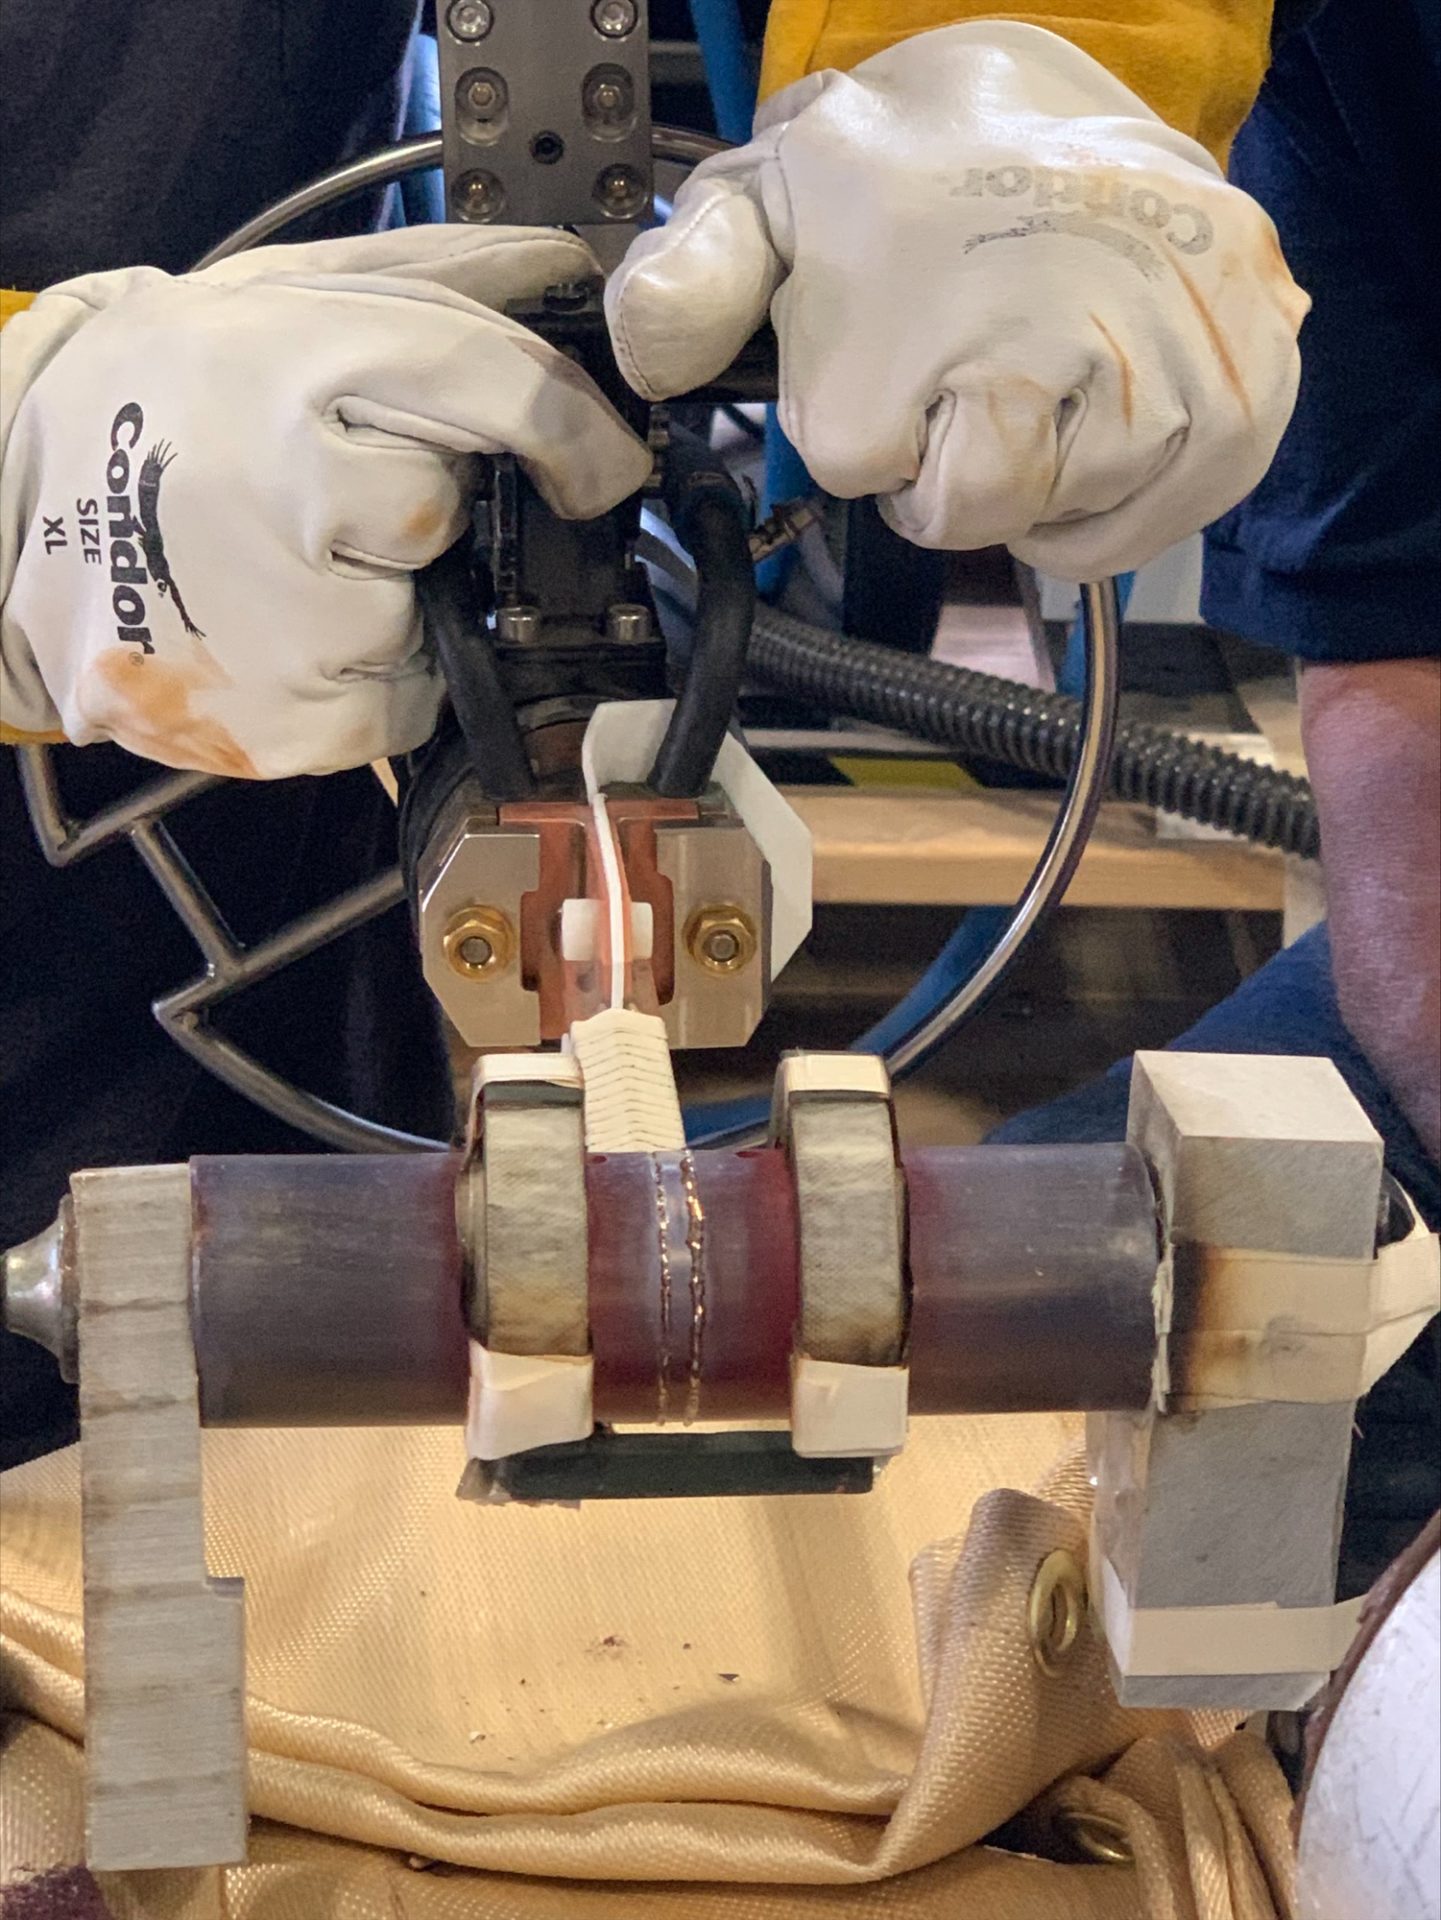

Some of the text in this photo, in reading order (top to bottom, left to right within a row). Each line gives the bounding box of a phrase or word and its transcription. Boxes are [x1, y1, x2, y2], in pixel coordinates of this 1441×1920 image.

[950, 164, 1214, 256] Condor
[42, 515, 68, 555] XL
[76, 498, 102, 565] SIZE
[106, 402, 156, 655] Condor
